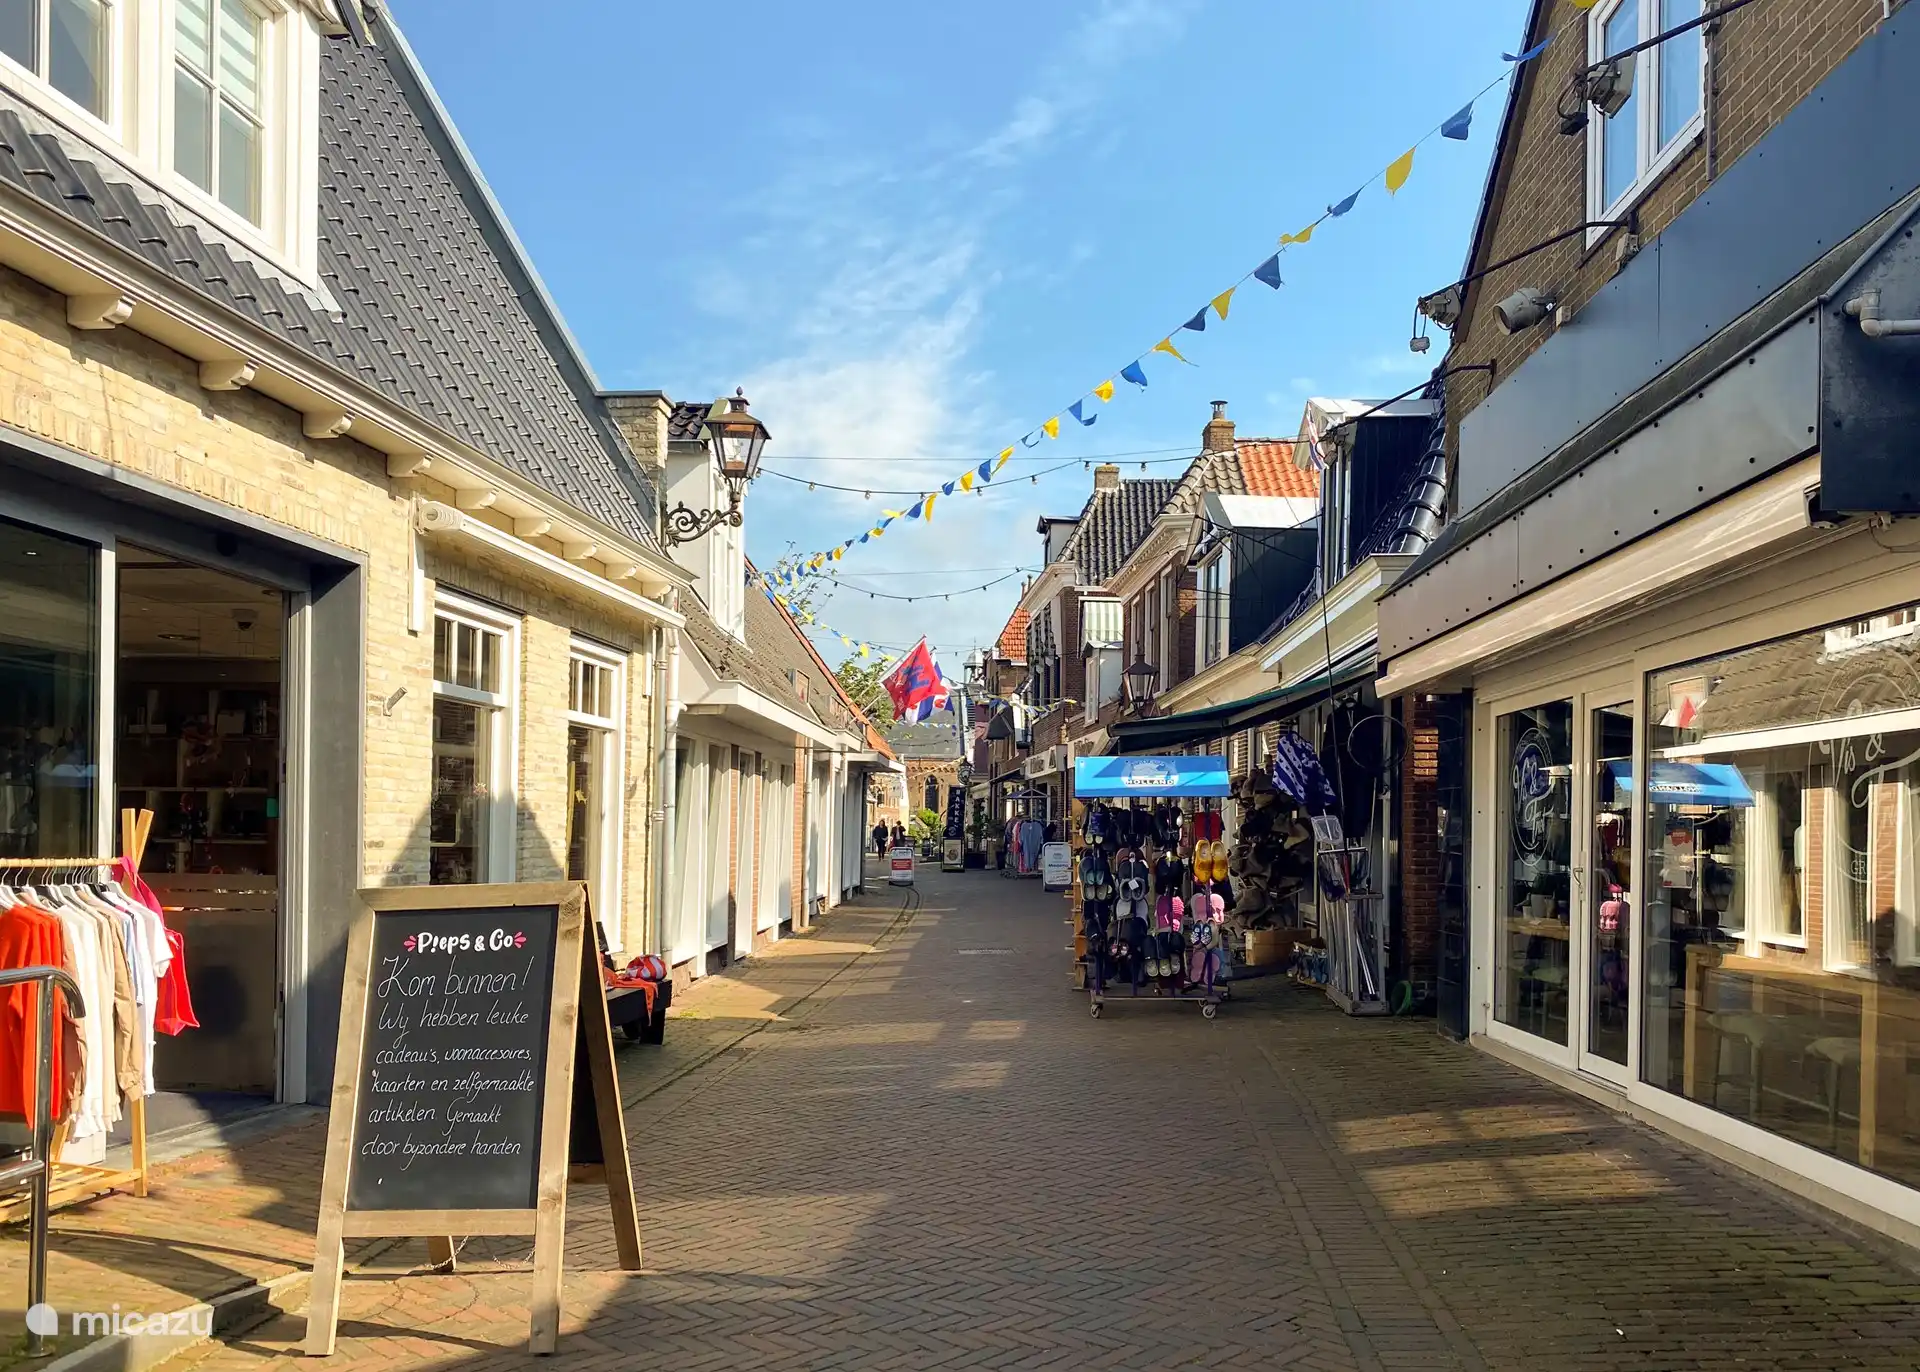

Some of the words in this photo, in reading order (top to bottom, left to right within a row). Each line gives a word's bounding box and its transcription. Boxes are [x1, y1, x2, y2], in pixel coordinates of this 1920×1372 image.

[474, 935, 486, 952] &
[489, 928, 514, 951] Co
[377, 955, 436, 998] Kom
[444, 955, 535, 995] binnen!
[420, 999, 480, 1028] hebben
[486, 999, 529, 1025] leuke
[371, 1069, 425, 1093] kaarten
[430, 1079, 449, 1091] en
[453, 1069, 535, 1104] zelfgemaakte
[441, 1096, 502, 1136] Gemaakt
[361, 1133, 400, 1155] door
[470, 1130, 522, 1155] handen
